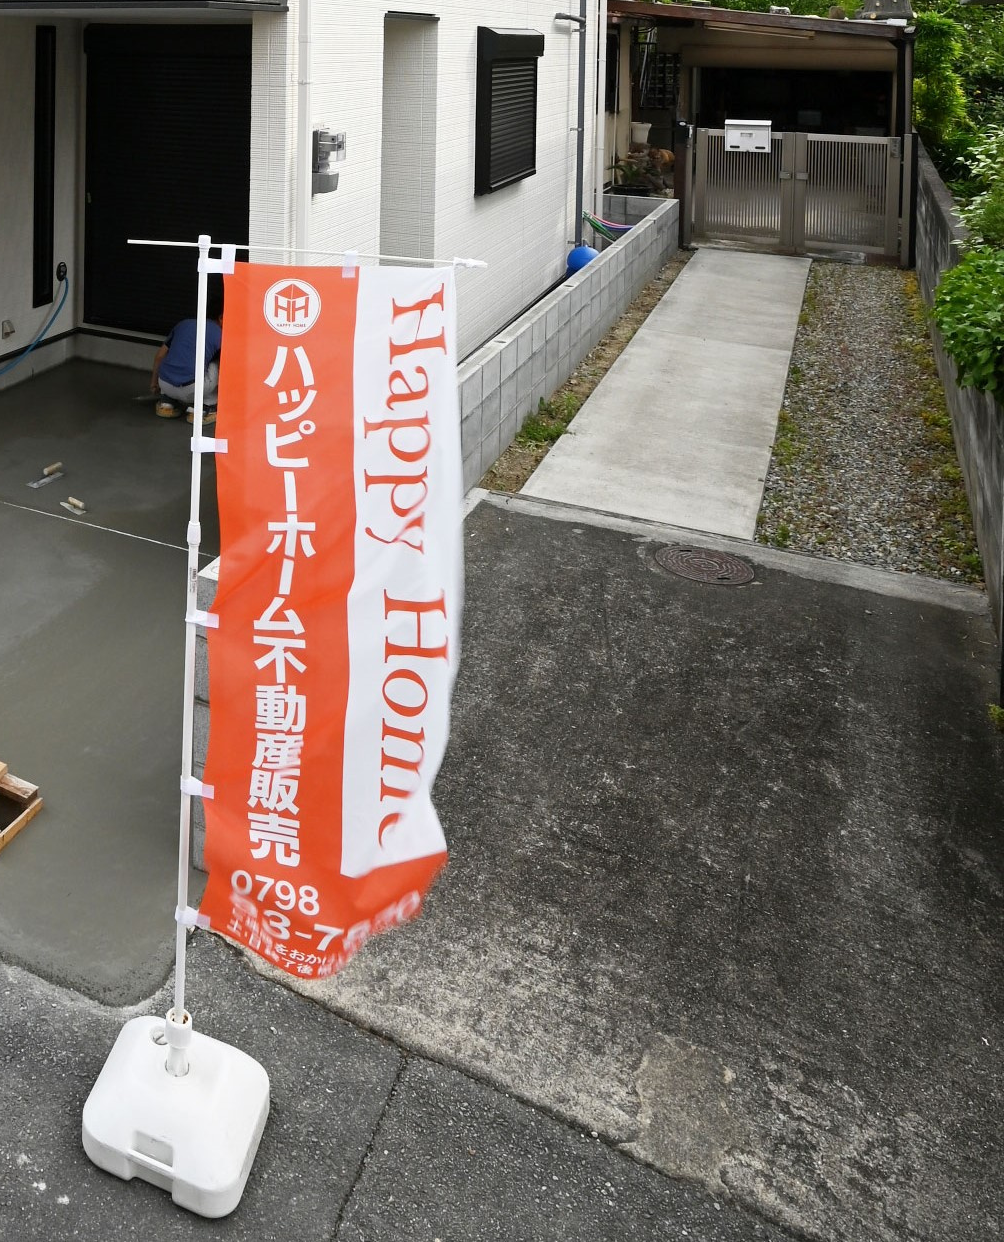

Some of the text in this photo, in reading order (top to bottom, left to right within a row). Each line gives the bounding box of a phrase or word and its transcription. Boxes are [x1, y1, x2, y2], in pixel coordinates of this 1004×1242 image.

[363, 283, 448, 555] Happy
[247, 346, 318, 867] ハッピーホーム不動産販売
[230, 869, 321, 916] 0798
